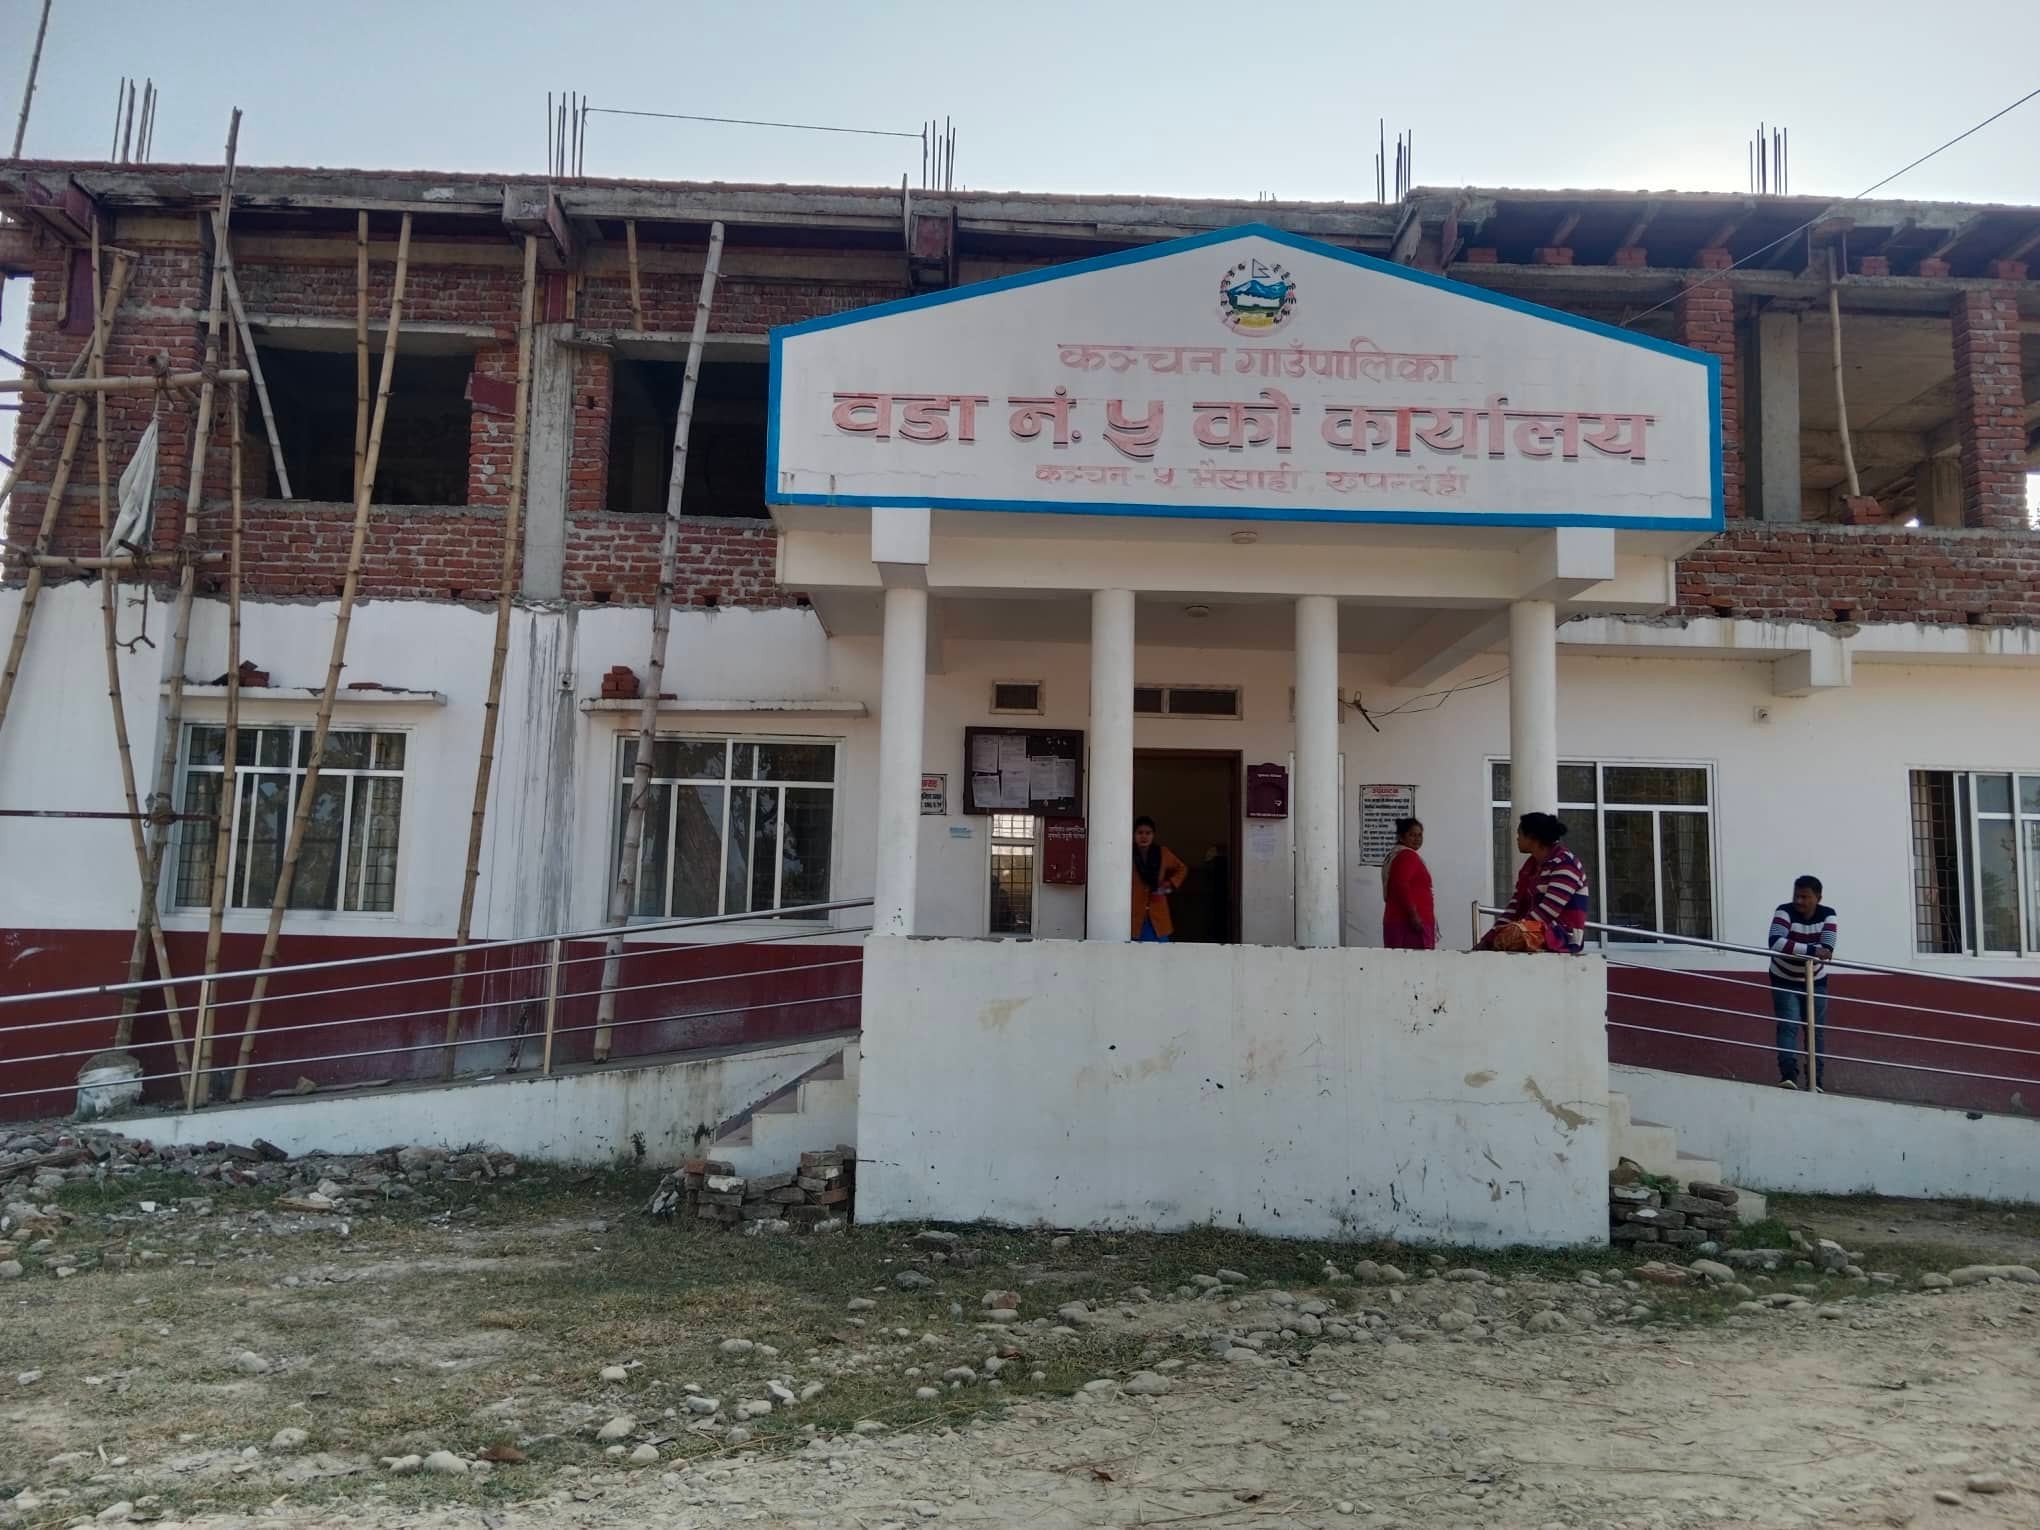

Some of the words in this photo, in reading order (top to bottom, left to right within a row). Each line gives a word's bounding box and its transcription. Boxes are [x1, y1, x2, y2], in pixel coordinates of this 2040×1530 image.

[1235, 336, 1458, 383] गाउँपालिका
[832, 392, 989, 441] वडा
[1008, 386, 1082, 445] नं.
[1102, 399, 1164, 461] ५
[1193, 387, 1300, 453] को
[1321, 394, 1657, 465] कार्यालय
